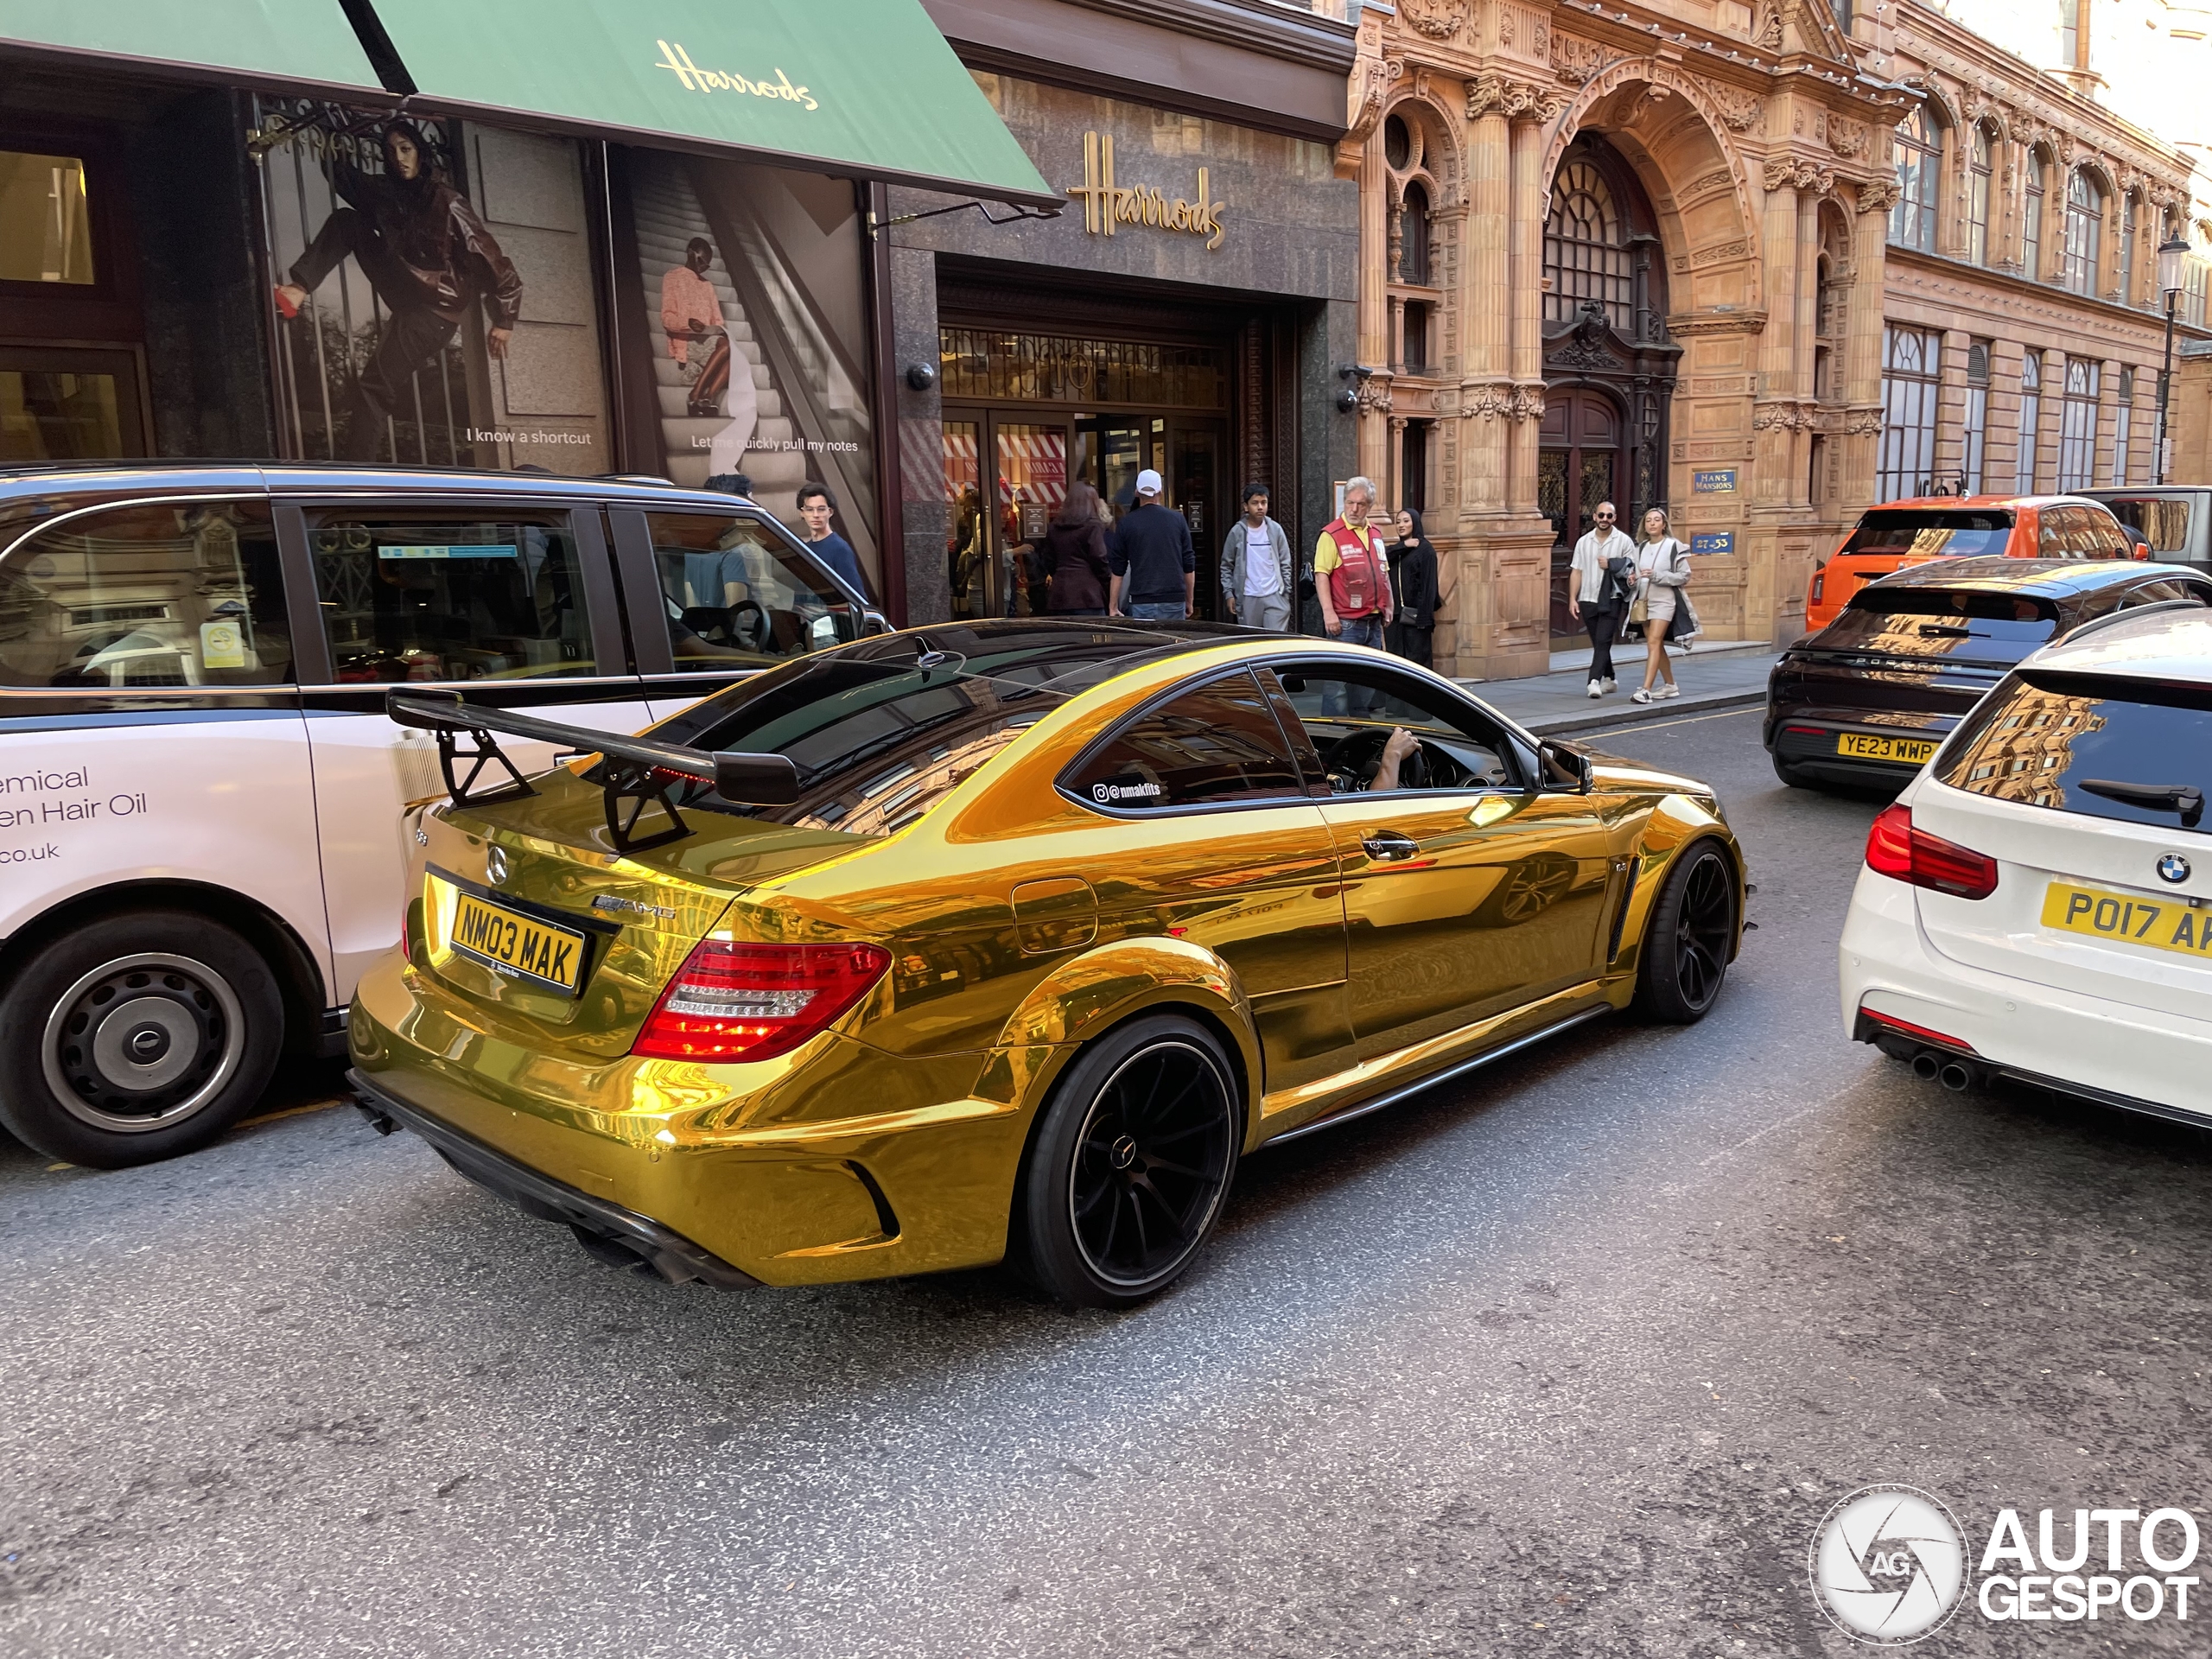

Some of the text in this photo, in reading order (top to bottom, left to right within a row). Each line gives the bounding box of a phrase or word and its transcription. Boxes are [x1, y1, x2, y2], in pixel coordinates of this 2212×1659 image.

[654, 39, 819, 111] Harrods
[1065, 130, 1226, 251] Harrods
[467, 427, 592, 445] I know a shortcut
[691, 435, 858, 453] Let me quickly pull my notes
[1695, 481, 1732, 490] MANSIONS
[1700, 474, 1728, 482] HANS
[1856, 657, 1963, 671] PORSCHE
[1847, 735, 1932, 760] YE23 WWP
[1109, 782, 1161, 799] @nmakfits
[41, 798, 102, 823] Hair
[109, 792, 147, 816] Oil
[2160, 854, 2190, 868] BMW
[2065, 893, 2161, 938] PO17
[460, 903, 573, 984] NM03 MAK
